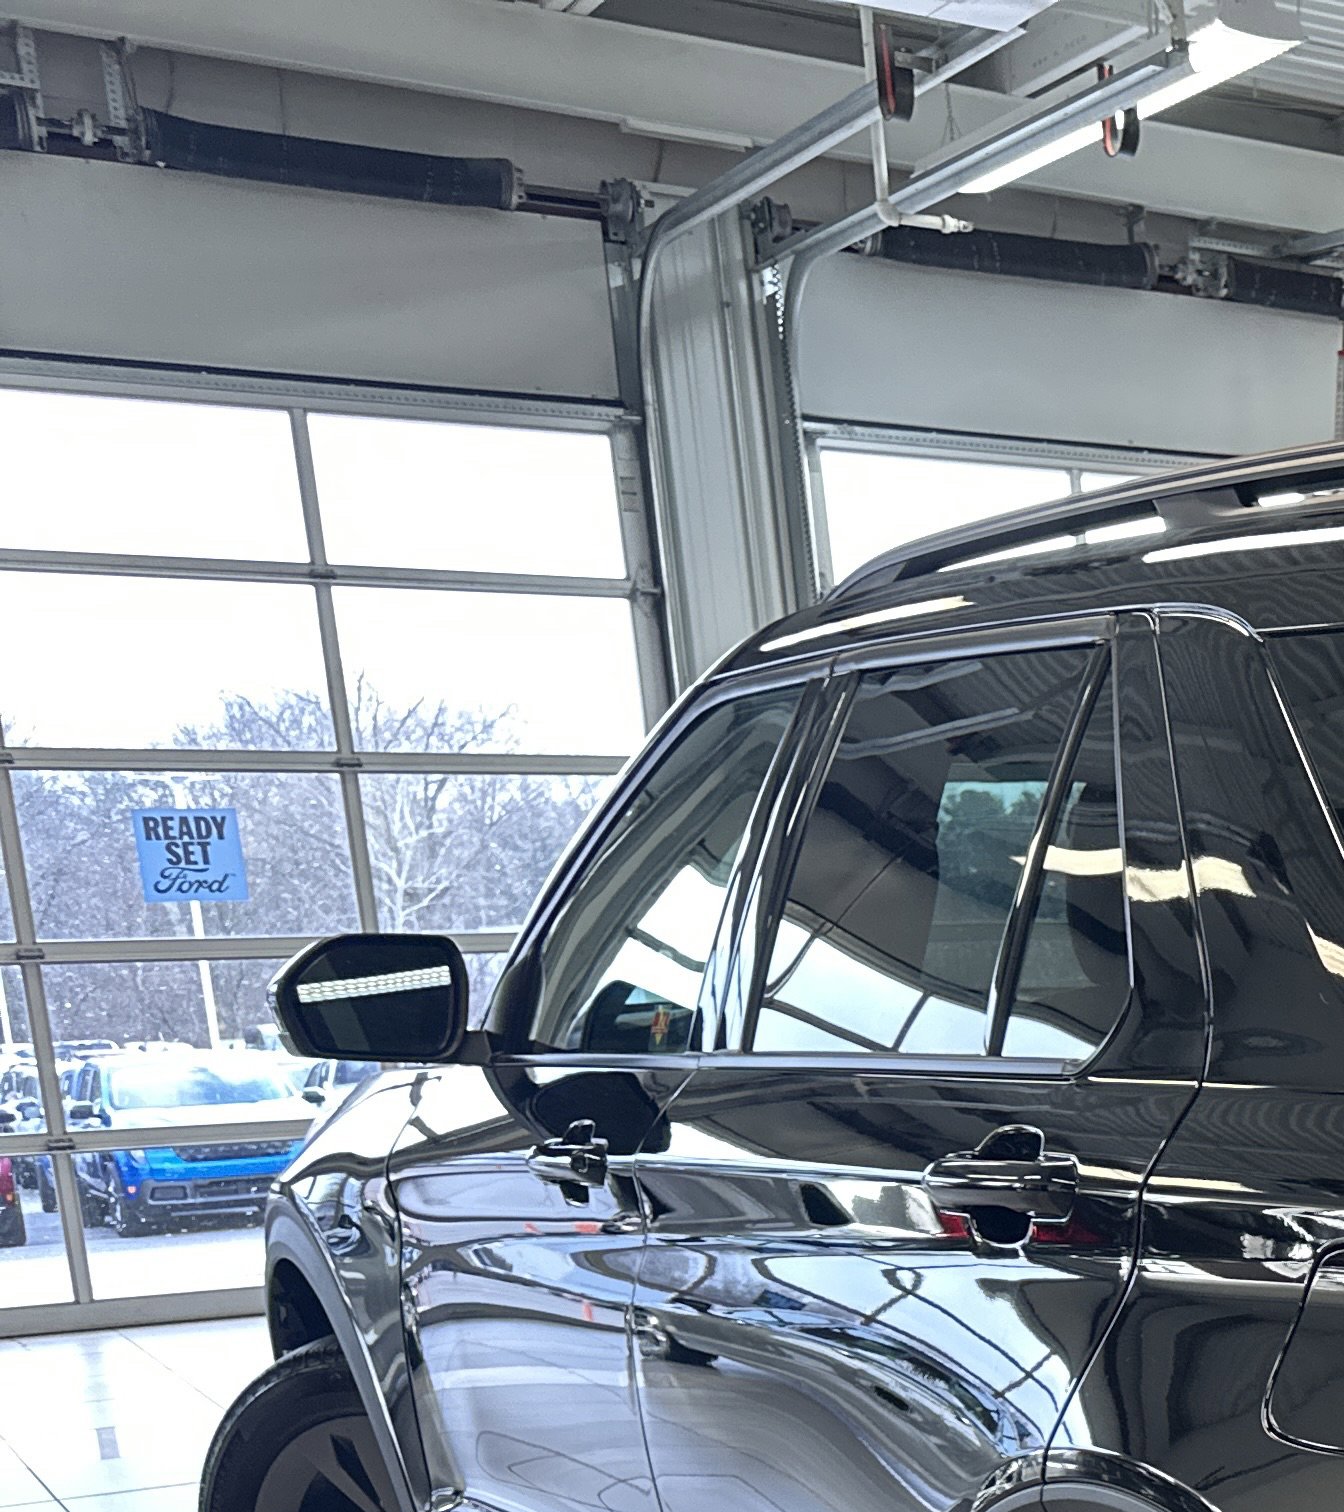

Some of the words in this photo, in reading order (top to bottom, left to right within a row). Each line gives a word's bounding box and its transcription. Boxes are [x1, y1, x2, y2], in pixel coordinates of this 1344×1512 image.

[142, 815, 226, 841] READY
[165, 841, 211, 866] SET
[153, 866, 230, 894] Ford
